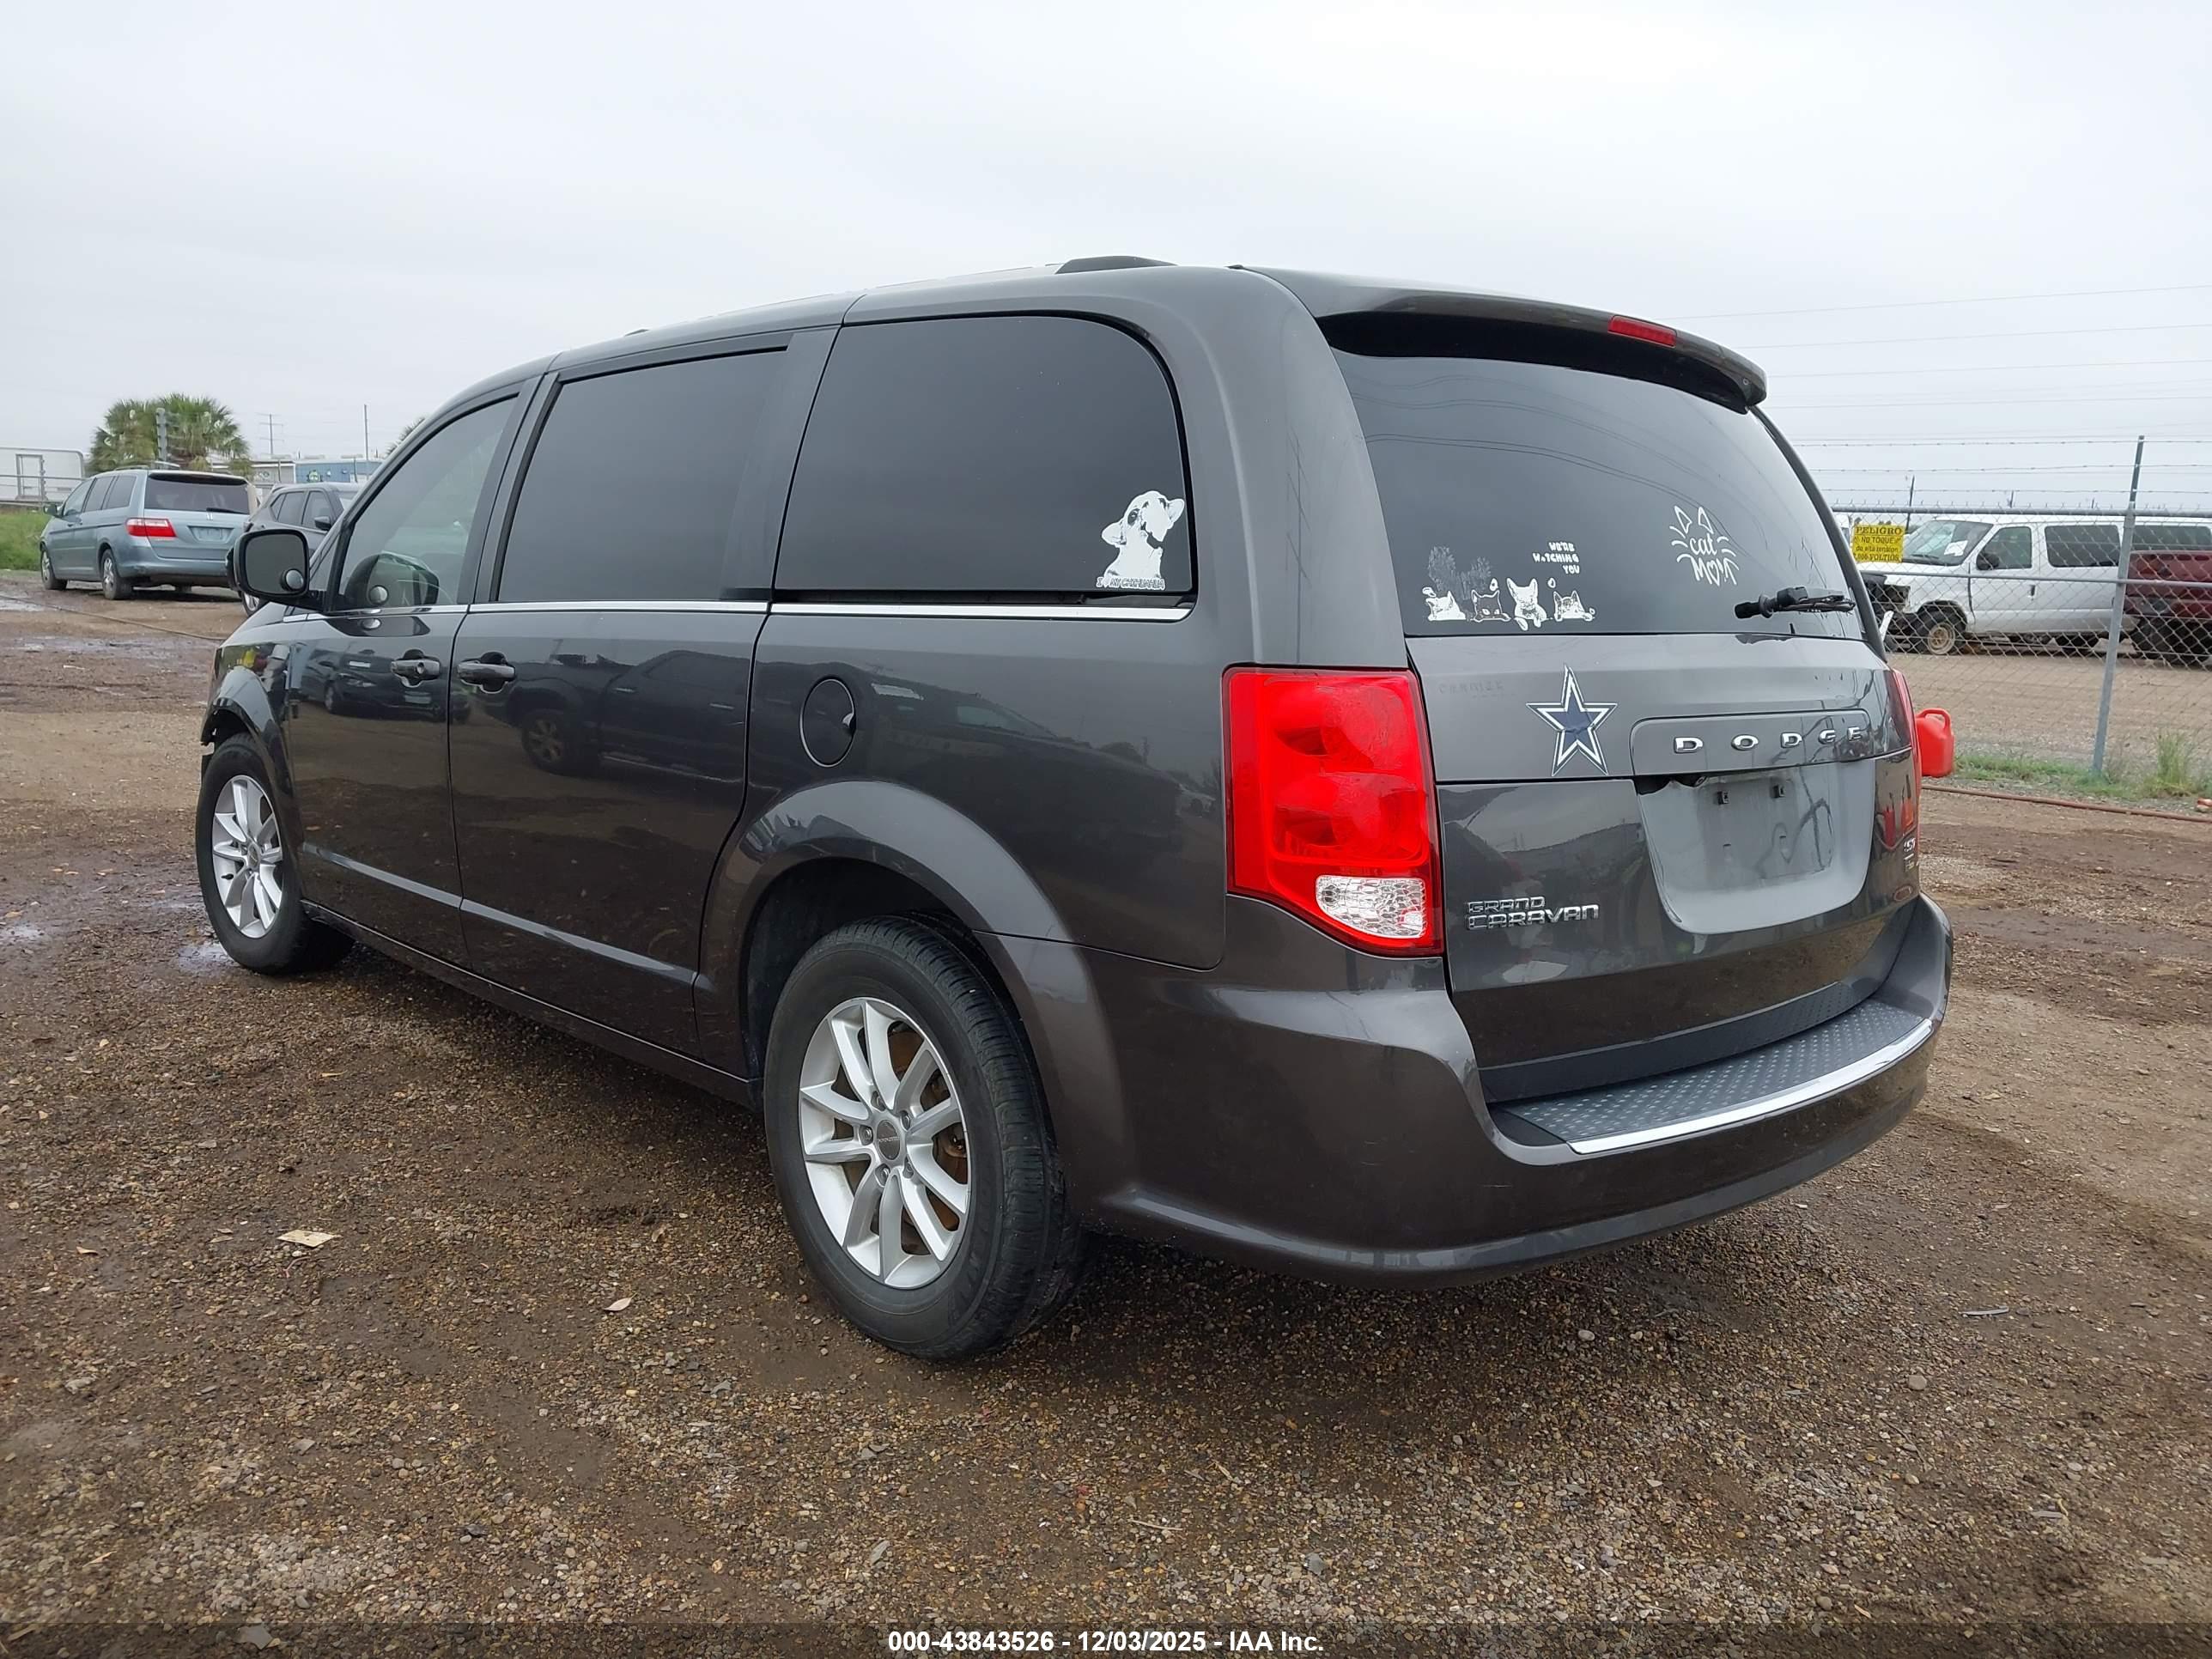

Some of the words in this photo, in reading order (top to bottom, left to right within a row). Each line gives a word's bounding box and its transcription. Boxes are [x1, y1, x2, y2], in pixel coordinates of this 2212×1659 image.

[1856, 526, 1902, 535] PELIGRO
[1690, 533, 1717, 556] cat
[1562, 564, 1580, 574] YOU
[1674, 726, 1862, 753] DODGE
[1468, 896, 1545, 913] GRAND
[1468, 904, 1599, 930] CARAVAN
